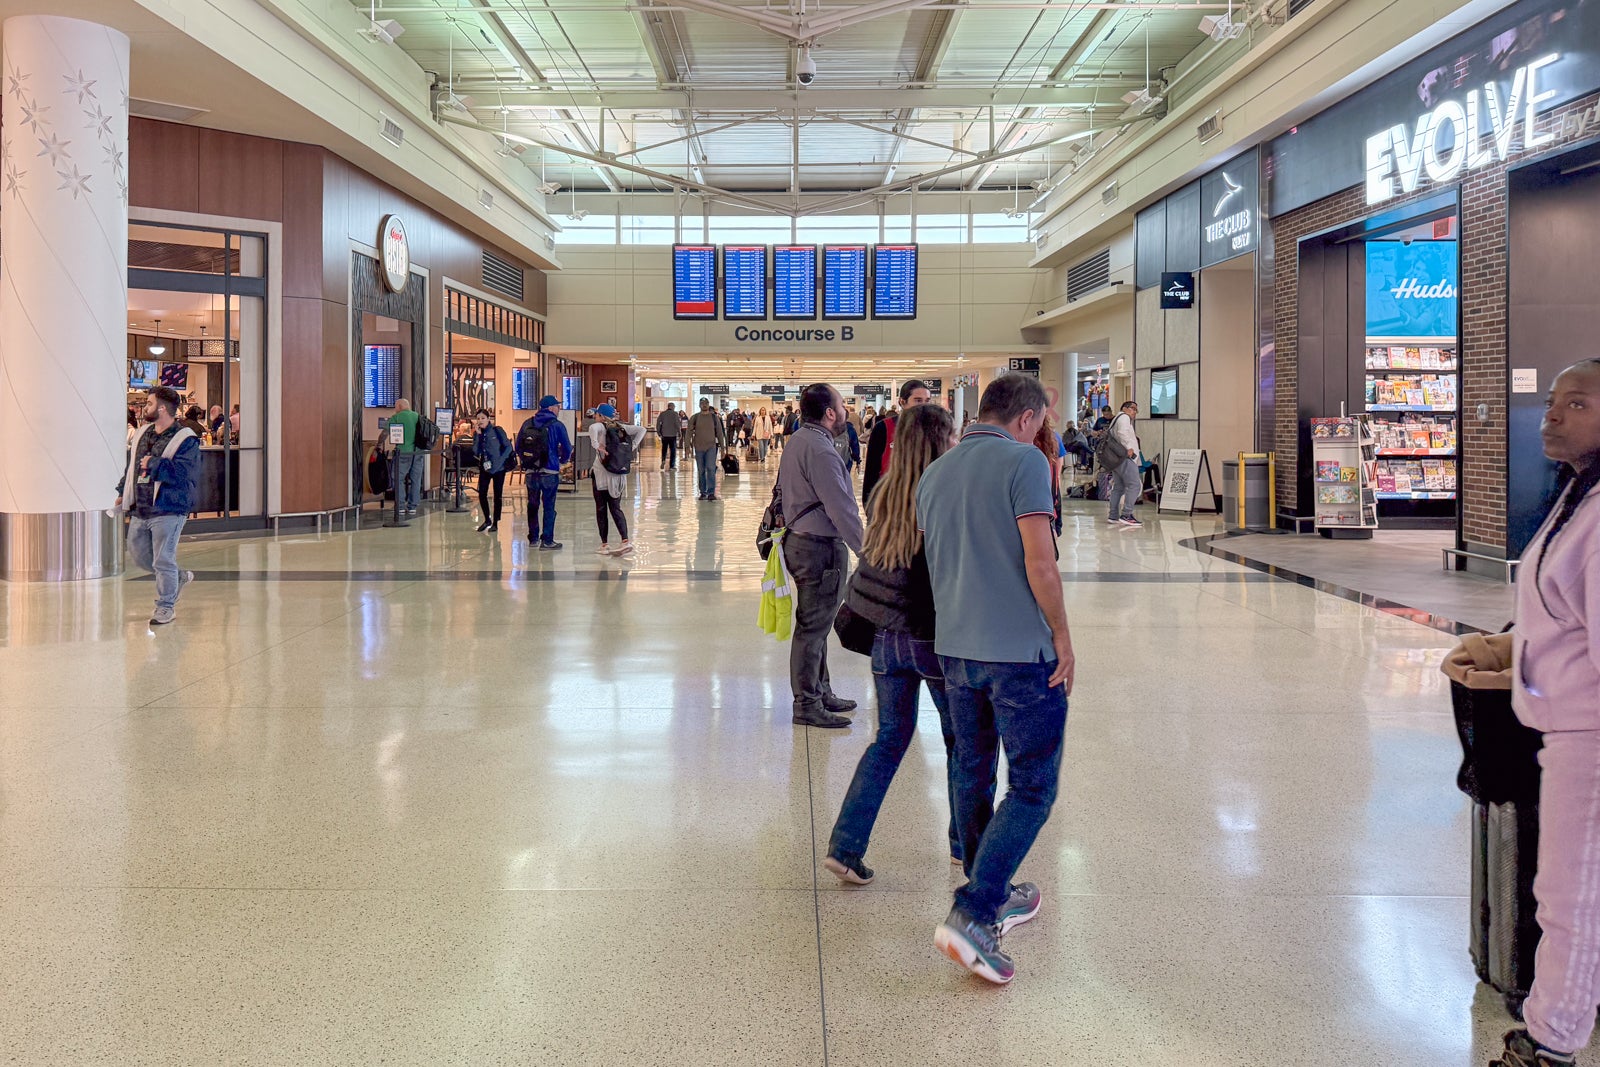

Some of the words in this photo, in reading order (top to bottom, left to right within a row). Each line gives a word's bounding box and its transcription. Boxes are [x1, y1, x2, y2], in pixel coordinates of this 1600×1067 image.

[1366, 53, 1560, 206] EVOLVE
[1561, 108, 1592, 138] by
[1205, 219, 1225, 243] THE
[1224, 209, 1251, 236] CLUB
[735, 326, 835, 341] Concourse
[841, 326, 854, 341] B
[1010, 359, 1025, 370] B1
